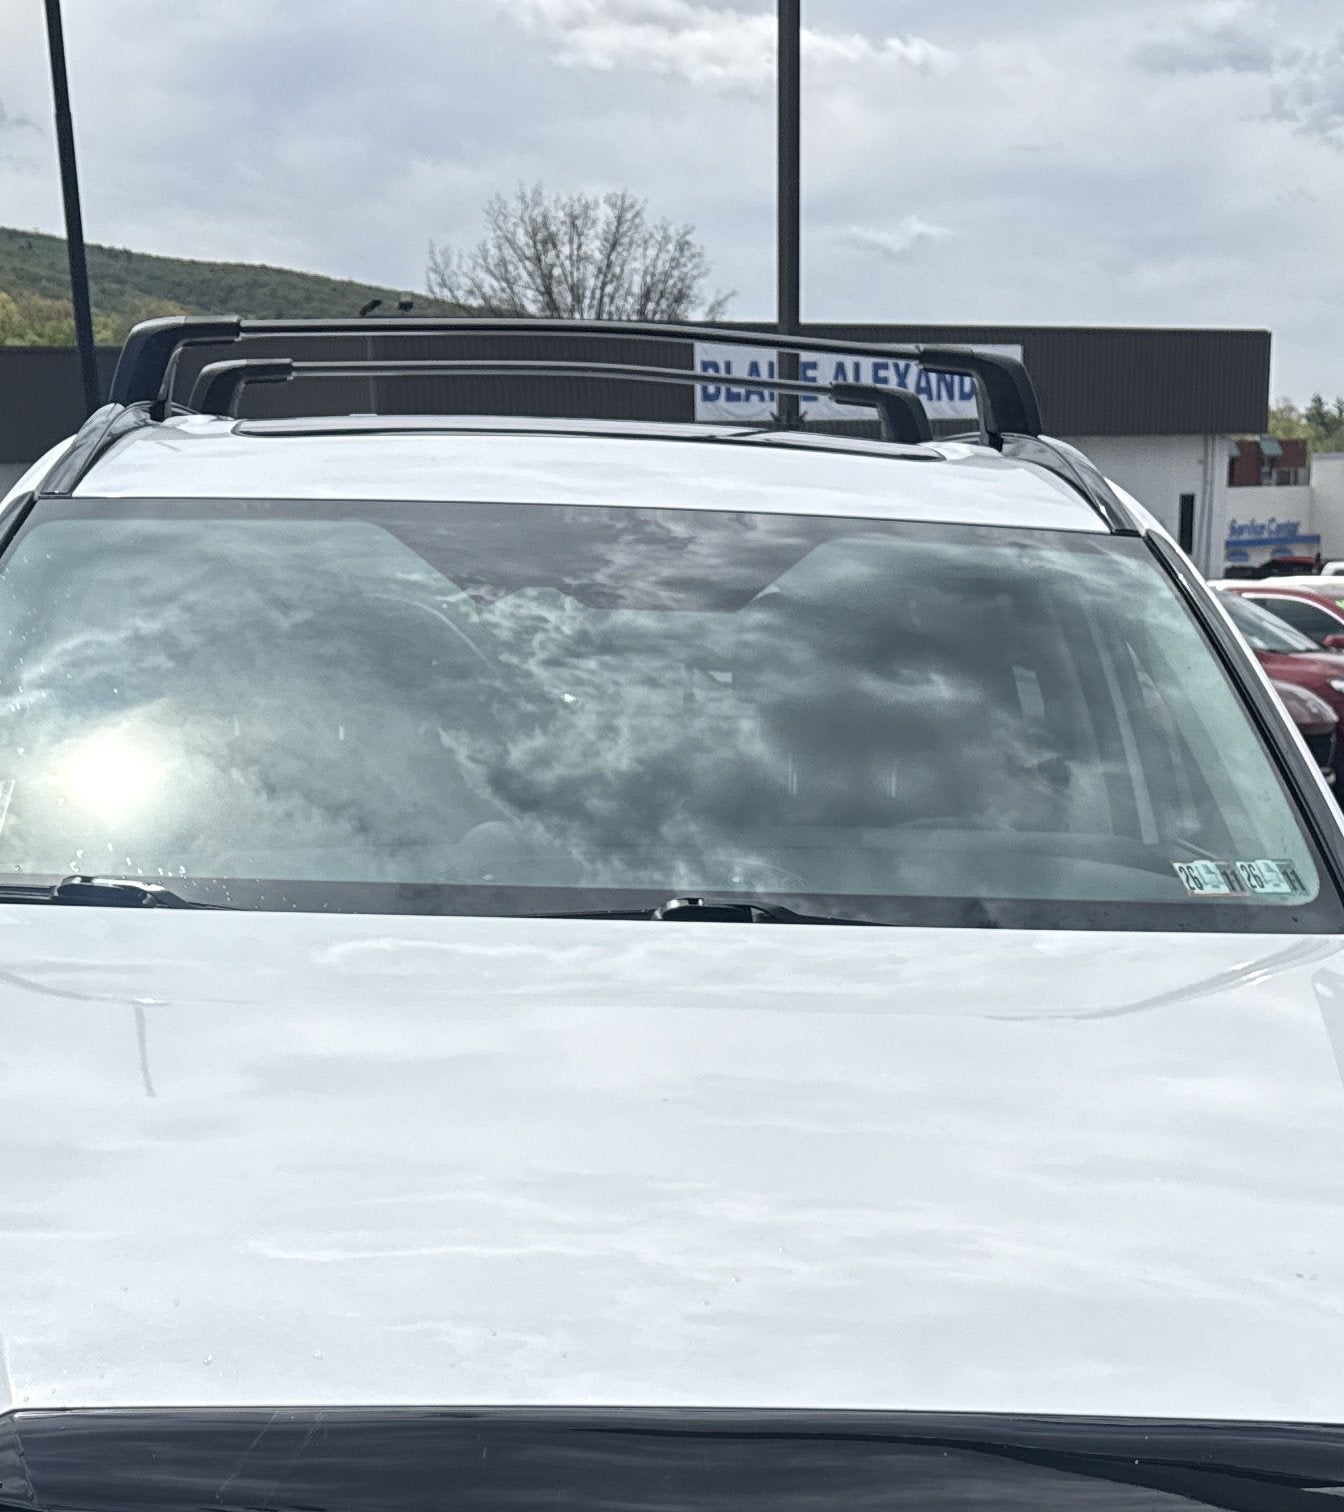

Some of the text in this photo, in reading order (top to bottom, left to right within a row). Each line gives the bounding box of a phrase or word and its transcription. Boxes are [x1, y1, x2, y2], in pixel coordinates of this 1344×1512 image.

[700, 360, 817, 402] BLAIE
[1178, 865, 1204, 891] 26
[1240, 863, 1265, 889] 26
